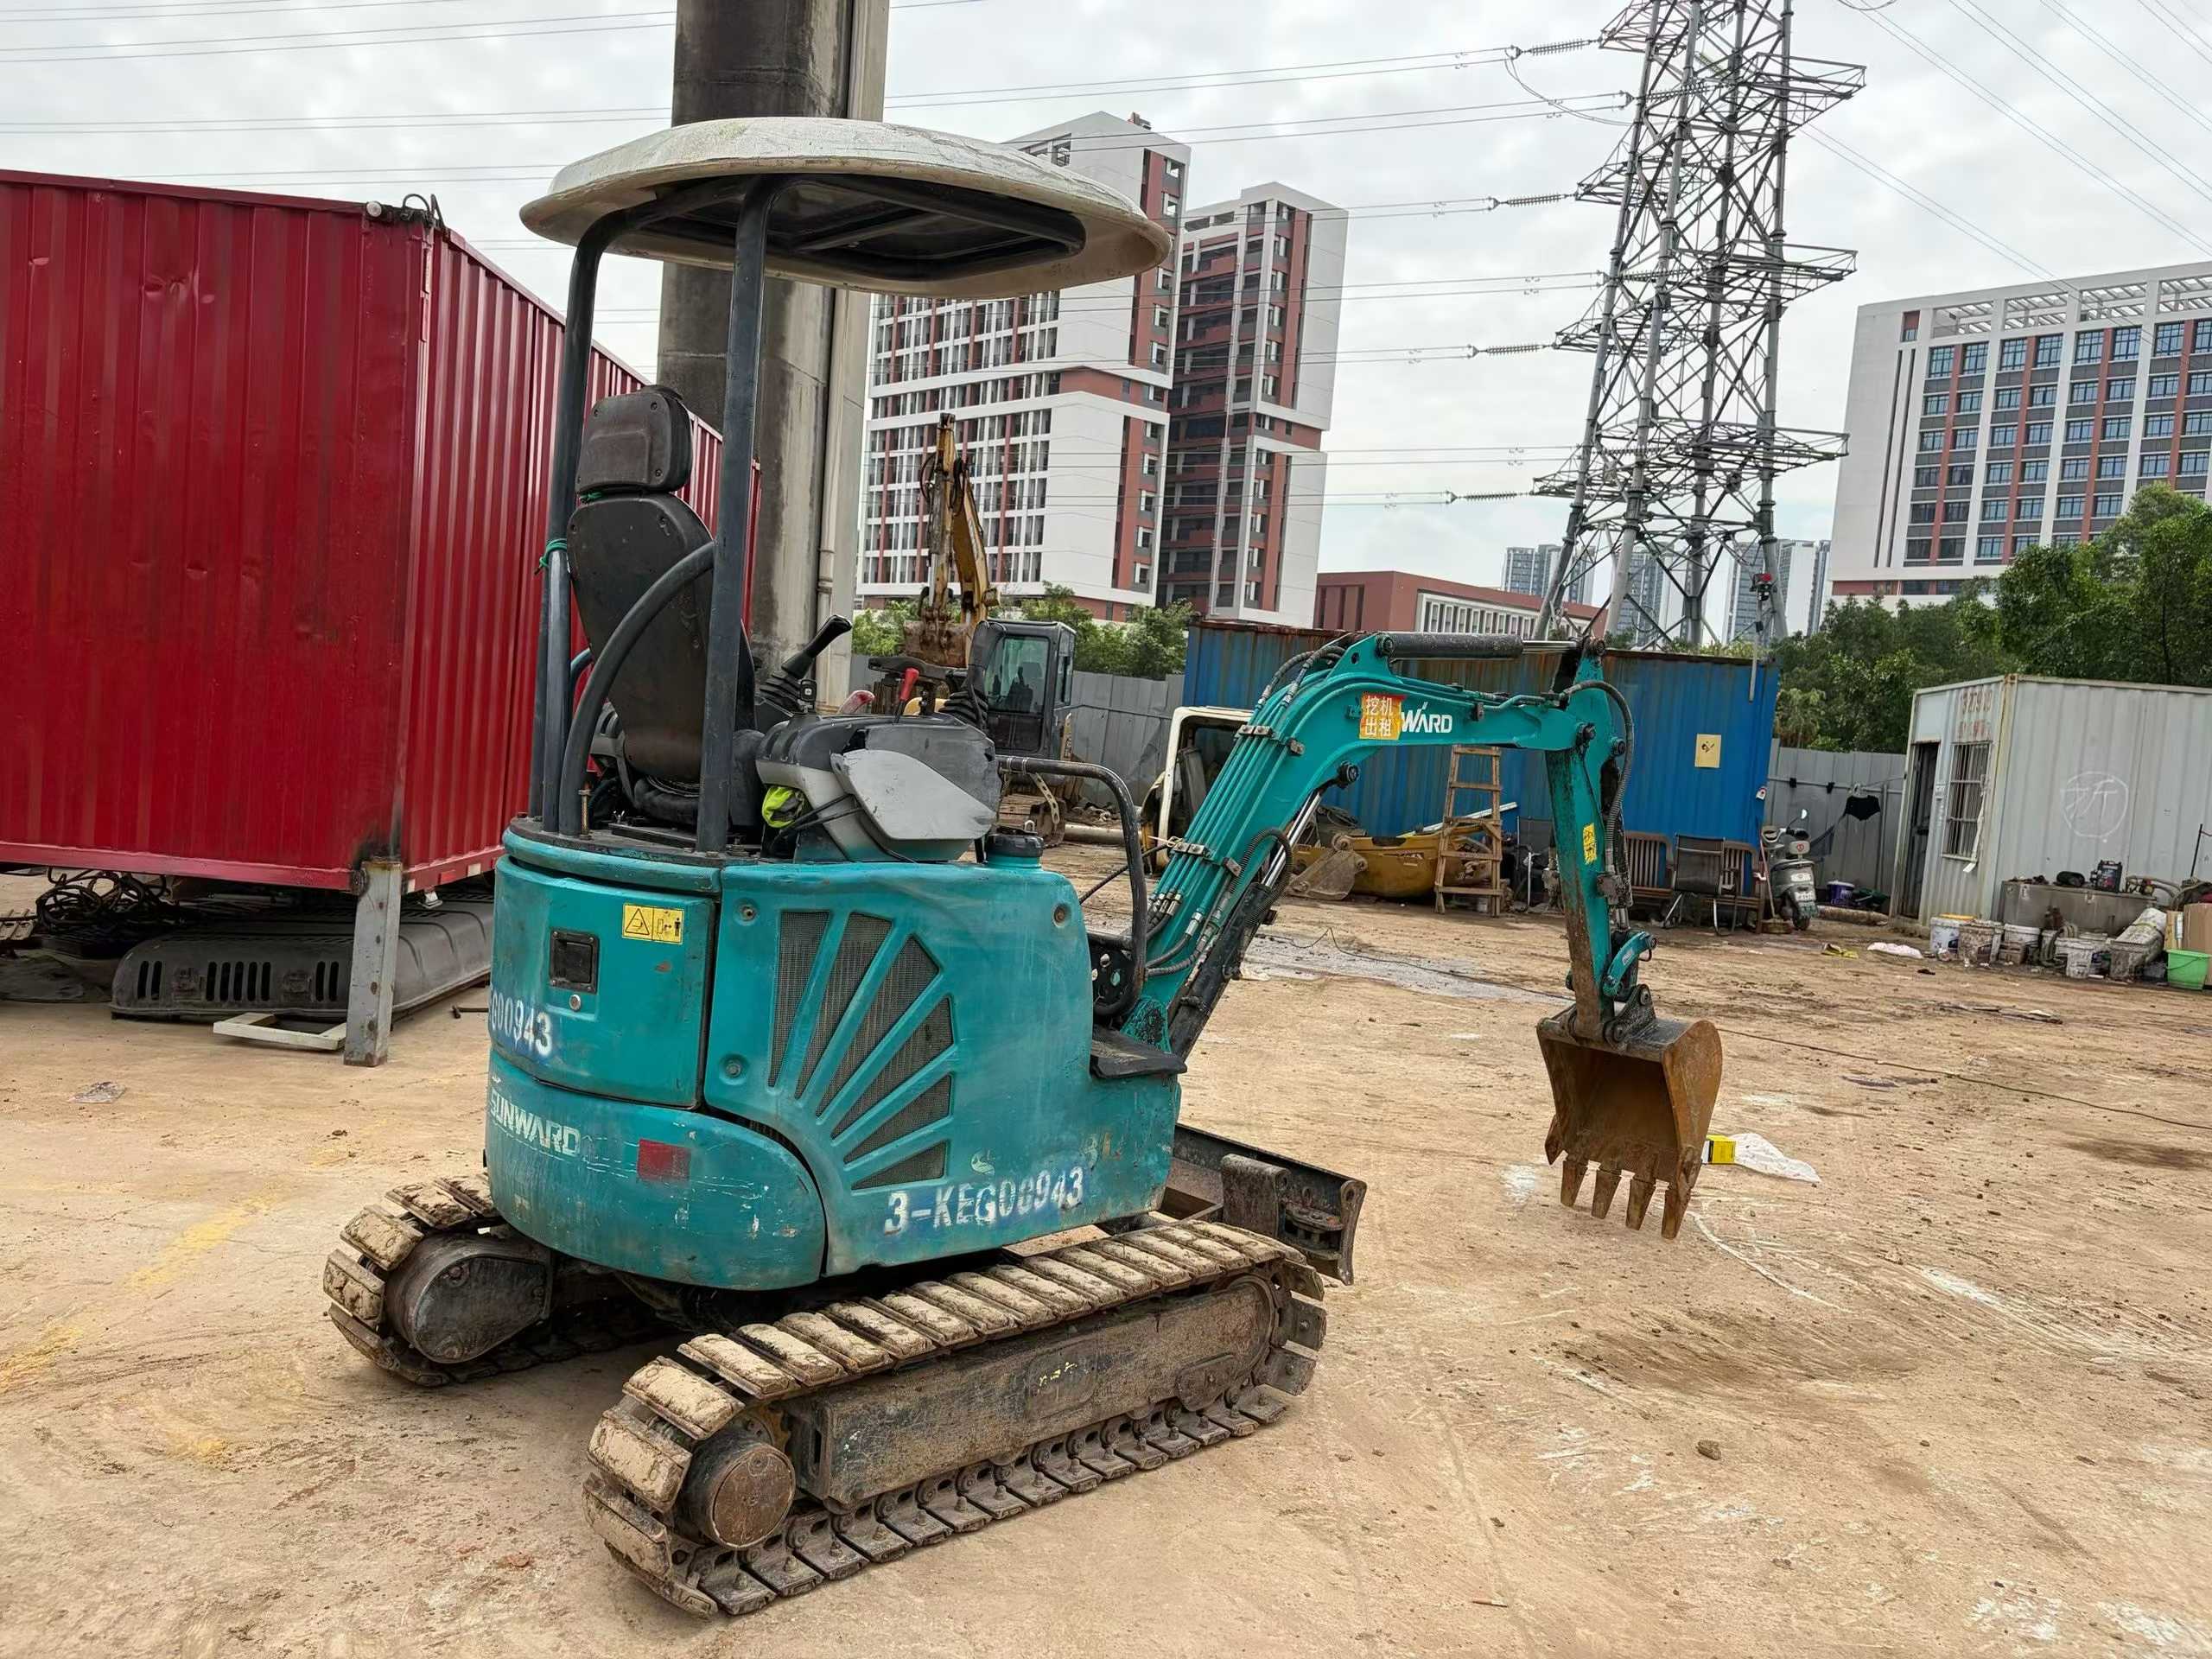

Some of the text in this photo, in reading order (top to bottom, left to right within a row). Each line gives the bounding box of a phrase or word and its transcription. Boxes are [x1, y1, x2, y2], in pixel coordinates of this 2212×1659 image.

[1366, 696, 1393, 716] 挖机
[1365, 717, 1392, 737] 出租
[489, 1086, 581, 1158] SUNWARD
